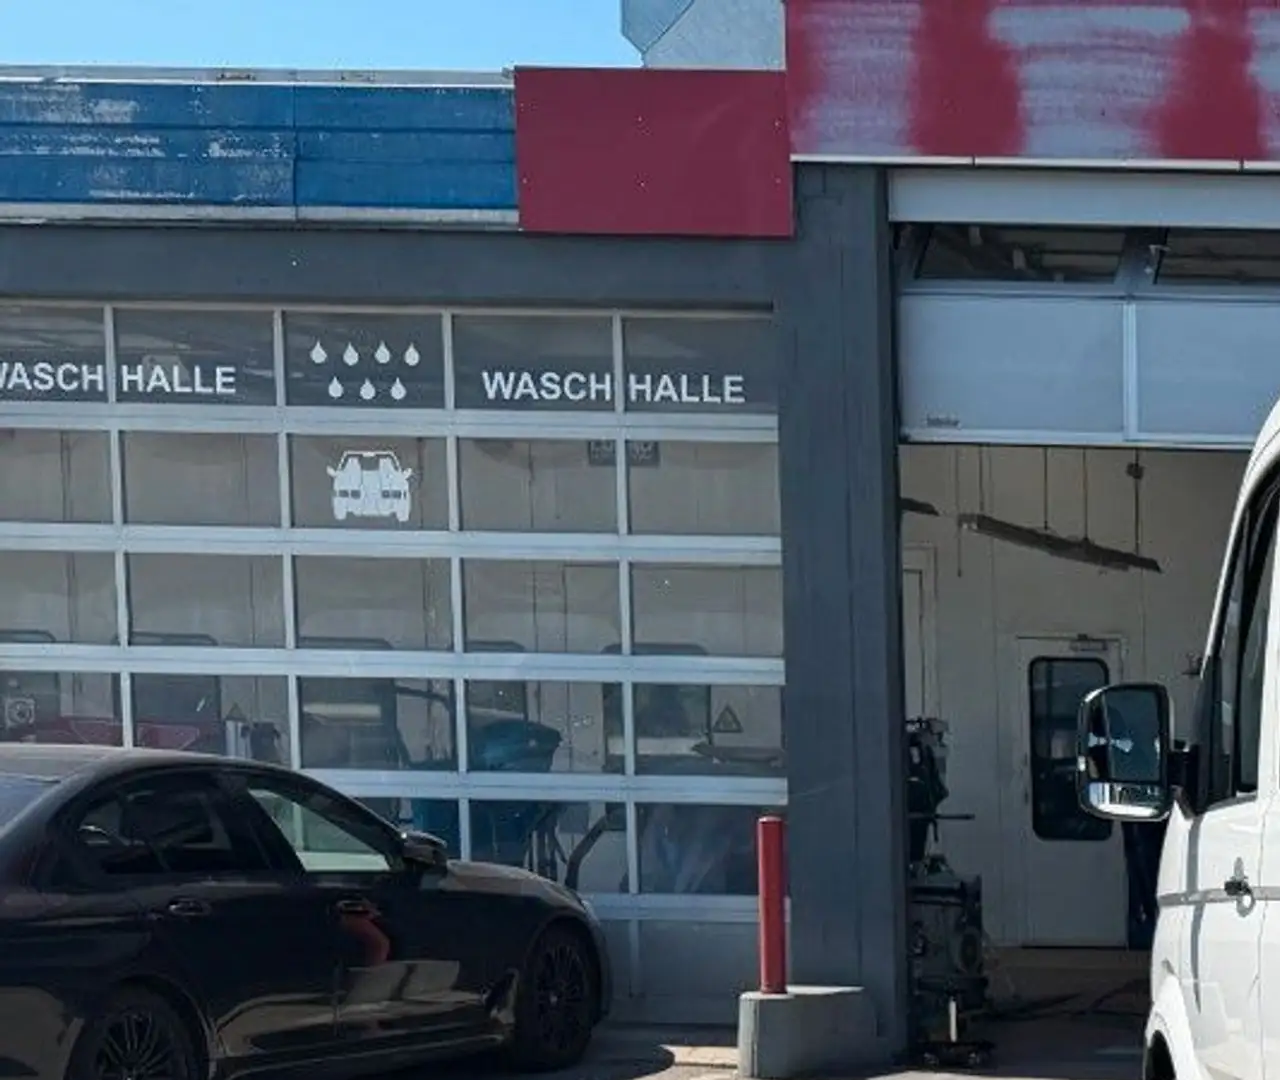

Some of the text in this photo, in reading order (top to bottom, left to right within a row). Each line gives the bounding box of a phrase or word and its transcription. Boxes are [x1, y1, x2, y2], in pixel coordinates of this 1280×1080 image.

[0, 362, 237, 394] ASCH HALLE
[482, 371, 746, 403] WASCH HALLE
